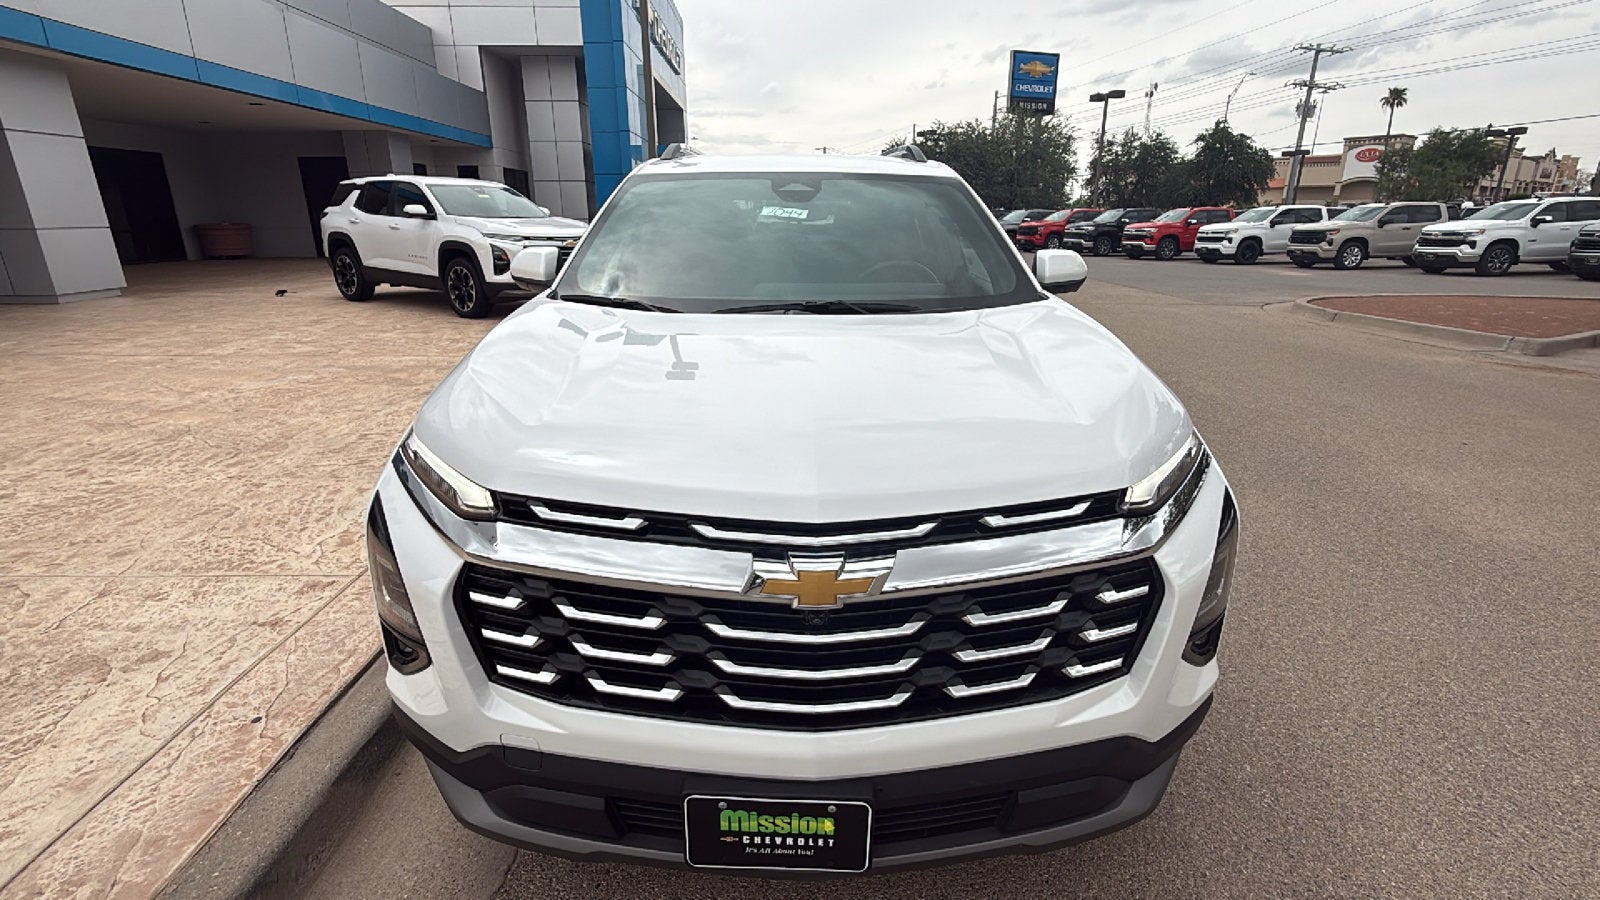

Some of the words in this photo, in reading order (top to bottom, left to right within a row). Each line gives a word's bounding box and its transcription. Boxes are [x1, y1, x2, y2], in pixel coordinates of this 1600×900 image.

[1015, 84, 1053, 93] CHEVROLET
[1019, 102, 1047, 110] MISSION
[720, 809, 835, 836] Mission
[742, 835, 835, 847] CHEVROLET
